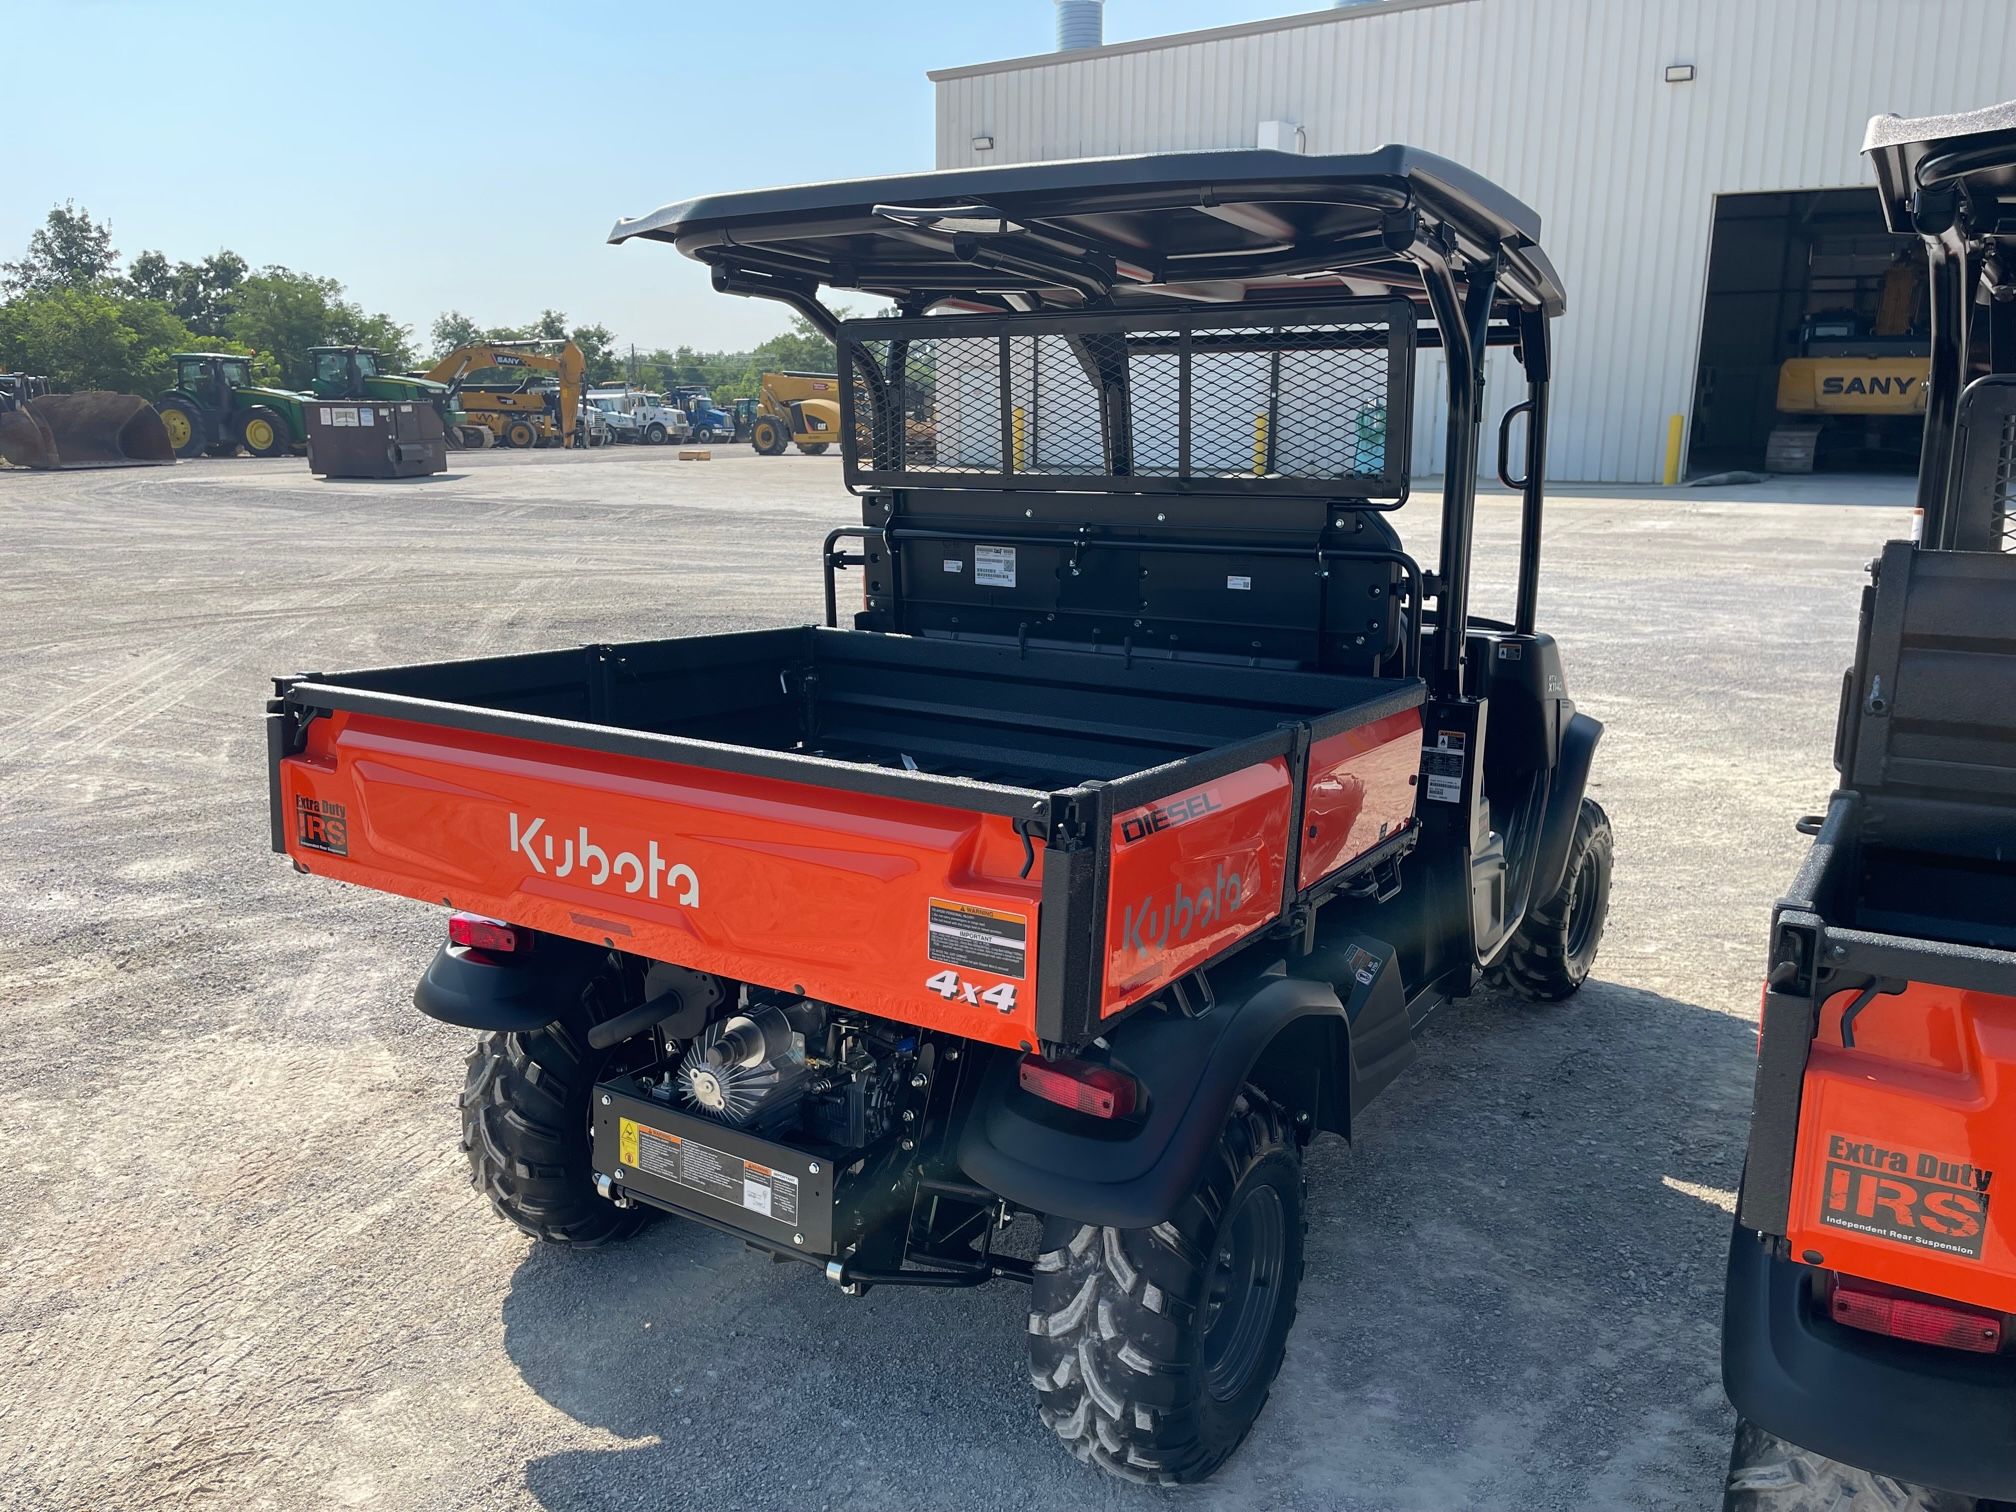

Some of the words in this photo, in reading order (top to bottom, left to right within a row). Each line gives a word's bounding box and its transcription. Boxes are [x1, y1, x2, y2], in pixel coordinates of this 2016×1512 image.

[497, 356, 519, 365] SANY
[1822, 377, 1916, 395] SANY
[296, 794, 320, 812] Extra
[322, 799, 345, 818] Duty
[1121, 792, 1221, 843] DIESEL
[299, 813, 346, 845] IRS
[509, 812, 699, 908] Kubota
[966, 906, 993, 918] WARNING
[1122, 863, 1242, 960] Kubota
[959, 930, 992, 943] IMPORTANT
[925, 970, 1018, 1014] 4x4
[1829, 1134, 1908, 1174] Extra
[1916, 1153, 1993, 1191] Duty
[1829, 1167, 1981, 1238] IRS
[1826, 1215, 1887, 1236] Independent
[1889, 1230, 1913, 1241] Rear
[1915, 1236, 1974, 1256] Suspension
